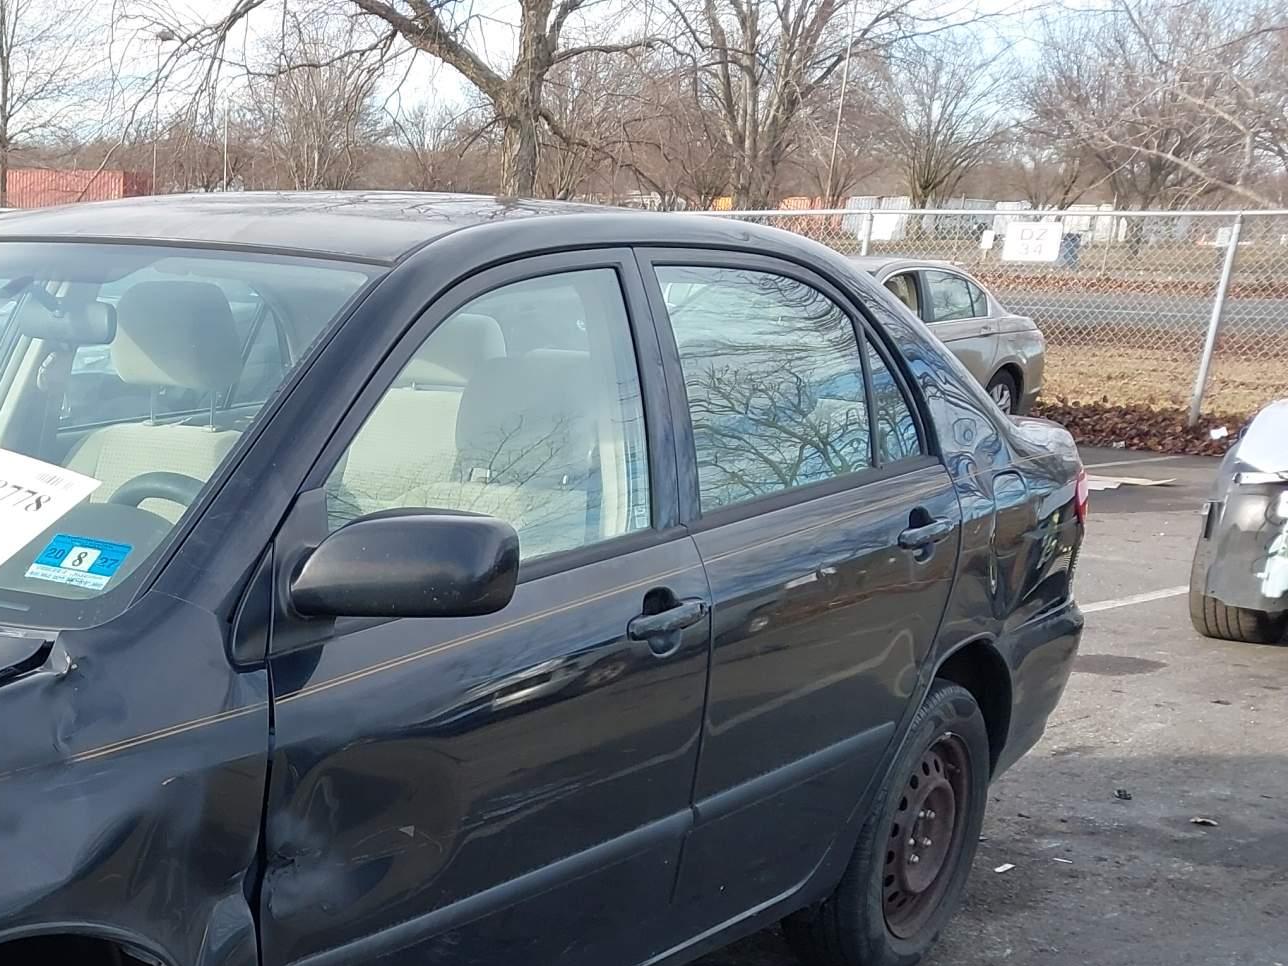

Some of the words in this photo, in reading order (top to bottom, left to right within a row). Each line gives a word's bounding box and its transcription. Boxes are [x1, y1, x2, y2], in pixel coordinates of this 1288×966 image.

[45, 547, 66, 560] 20
[71, 551, 89, 567] 8
[97, 556, 120, 569] 27
